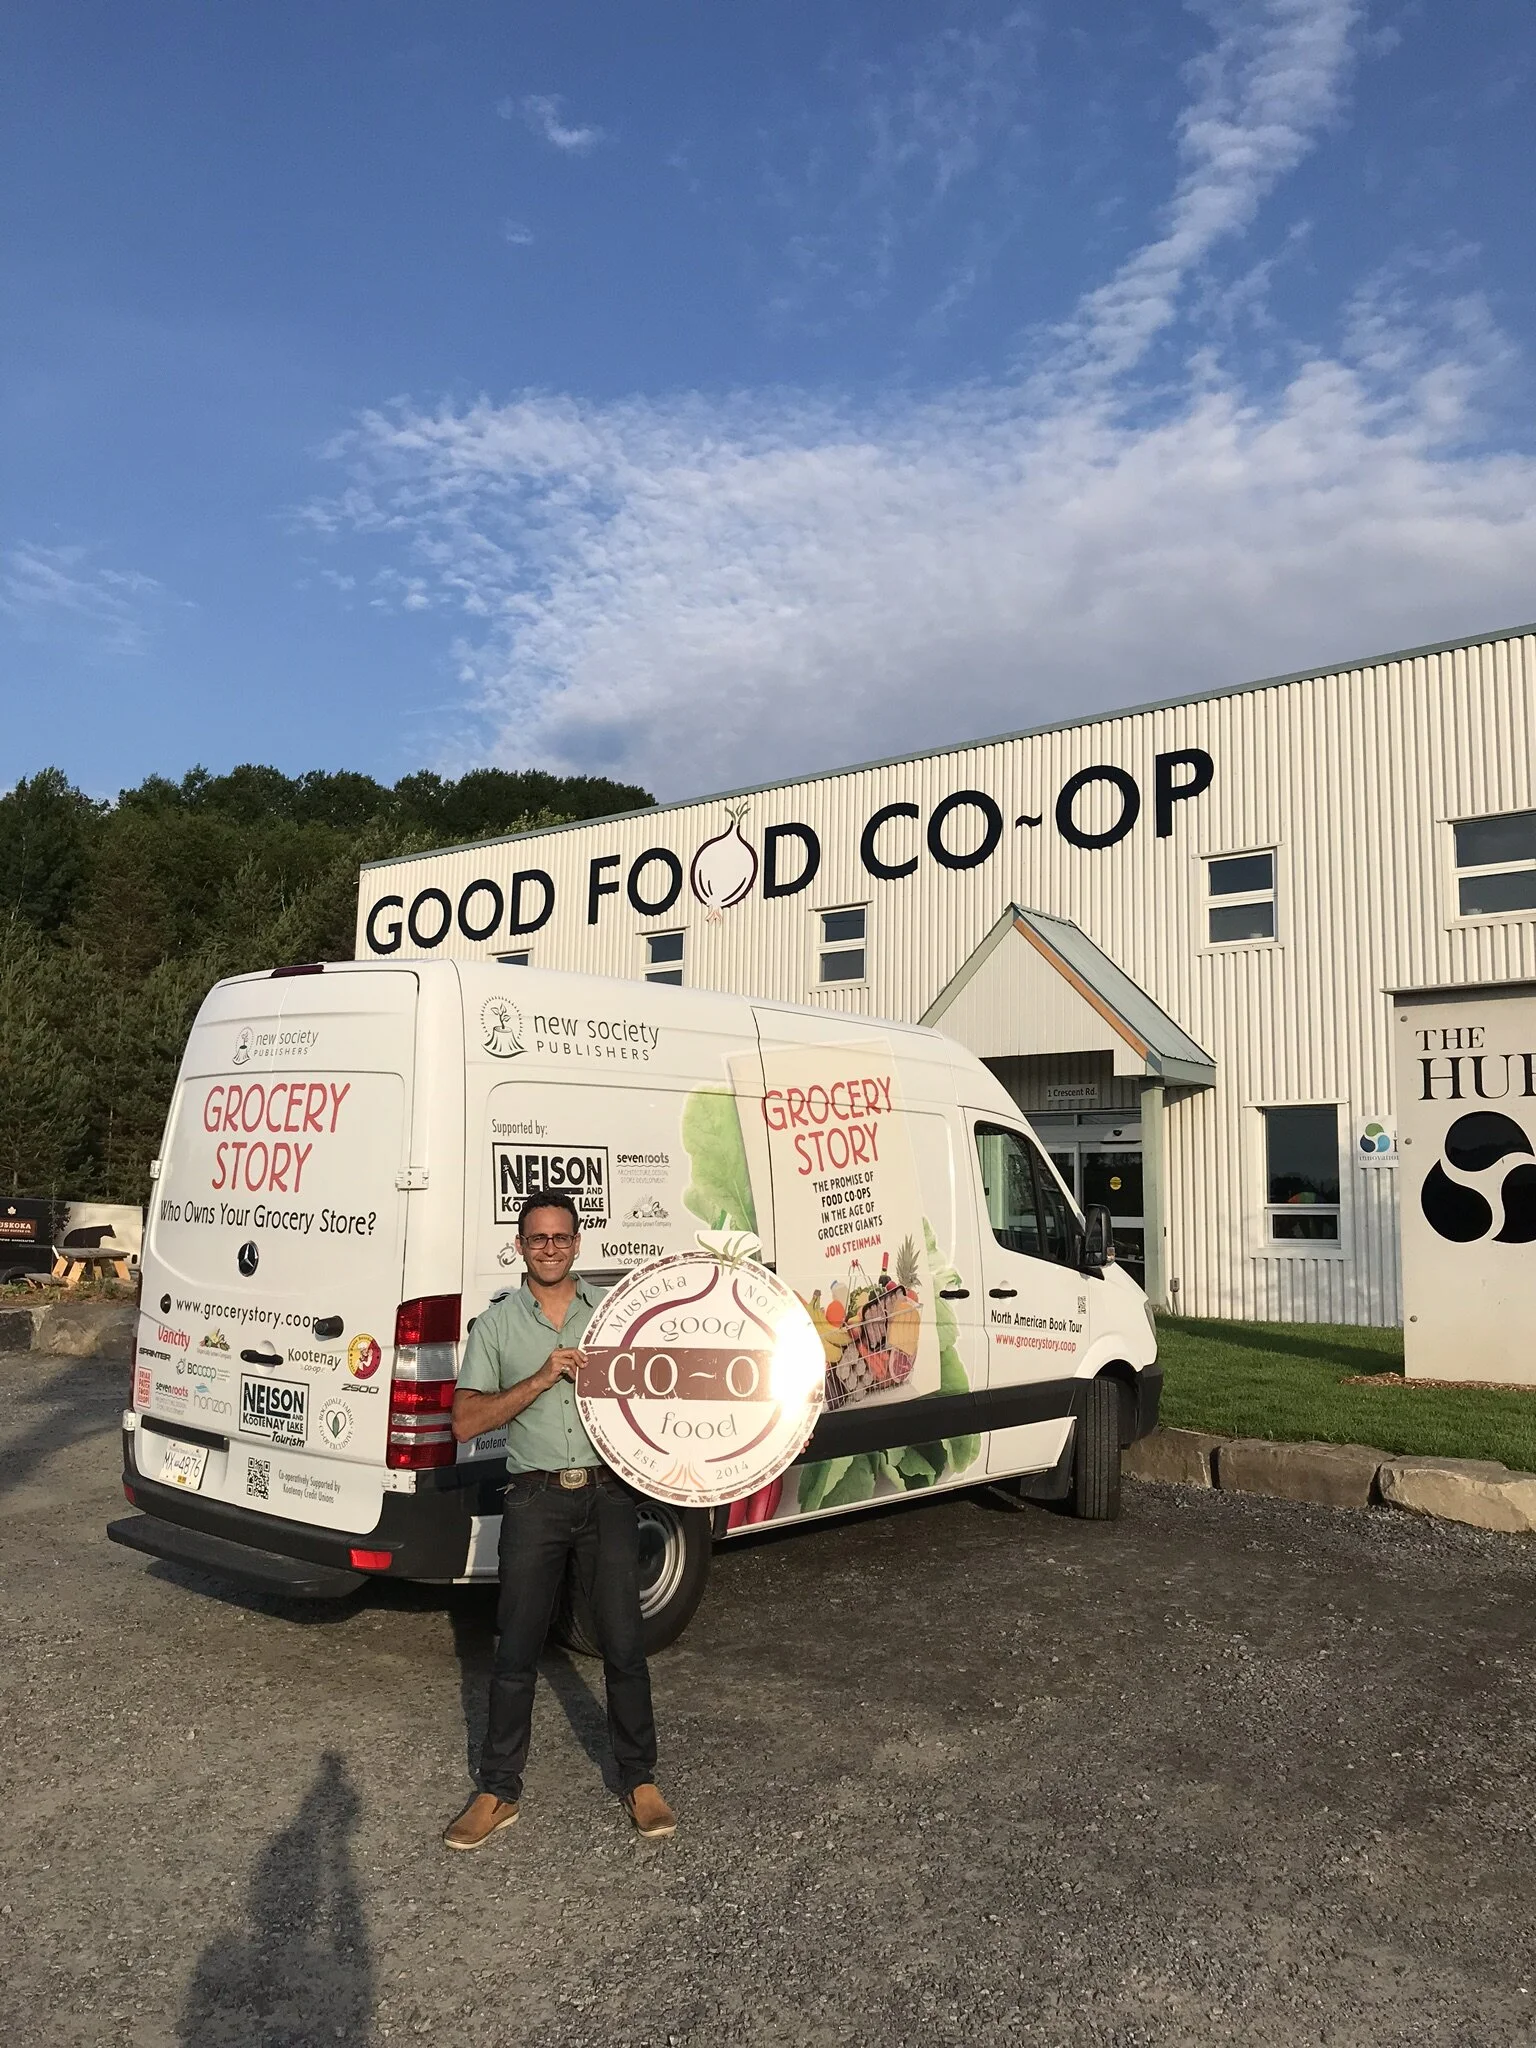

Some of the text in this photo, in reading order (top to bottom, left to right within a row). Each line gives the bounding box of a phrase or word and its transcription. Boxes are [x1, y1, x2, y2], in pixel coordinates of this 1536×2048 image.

[366, 869, 556, 956] GOOD
[255, 1029, 320, 1048] new society
[534, 1014, 660, 1050] new society
[1415, 1026, 1485, 1051] THE
[253, 1047, 308, 1057] PUBLISHERS
[536, 1040, 650, 1061] PUBLISHERS
[761, 1076, 893, 1131] GROCERY
[1053, 1088, 1084, 1097] Crescent
[203, 1082, 351, 1133] GROCERY
[491, 1118, 548, 1138] Supported by:
[794, 1121, 879, 1175] STORY
[211, 1141, 313, 1193] STORY
[500, 1153, 603, 1195] NELSON
[586, 1187, 603, 1195] AND
[812, 1171, 874, 1194] THE PROMISE OF
[579, 1197, 604, 1212] LAKE
[821, 1187, 871, 1208] FOOD CO-OPS
[160, 1200, 377, 1236] Who Owns Your Grocery Store?
[578, 1214, 607, 1230] rism
[821, 1201, 875, 1224] IN THE AGE OF
[817, 1214, 883, 1241] GROCERY GIANTS
[825, 1234, 882, 1258] JON STEINMAN
[176, 1298, 320, 1334] www.grocerystory.coop
[609, 1275, 688, 1333] Muskoka
[659, 1316, 746, 1342] good
[990, 1309, 1083, 1334] North American Book Tour
[157, 1325, 191, 1352] Vancity
[995, 1333, 1077, 1354] www.grocerystory.coop
[138, 1347, 171, 1361] SPRINTER
[287, 1348, 342, 1371] Kootenay
[243, 1381, 305, 1419] NELSON
[341, 1383, 380, 1394] 2500
[242, 1411, 304, 1435] KOOTENAY LAKE
[292, 1413, 304, 1422] AND
[660, 1411, 738, 1440] food
[271, 1430, 306, 1448] Tourism
[632, 1448, 749, 1480] Est. 2014
[283, 1482, 335, 1504] Kootenay Credit Unions
[310, 1475, 334, 1491] Supported
[333, 1480, 342, 1495] by
